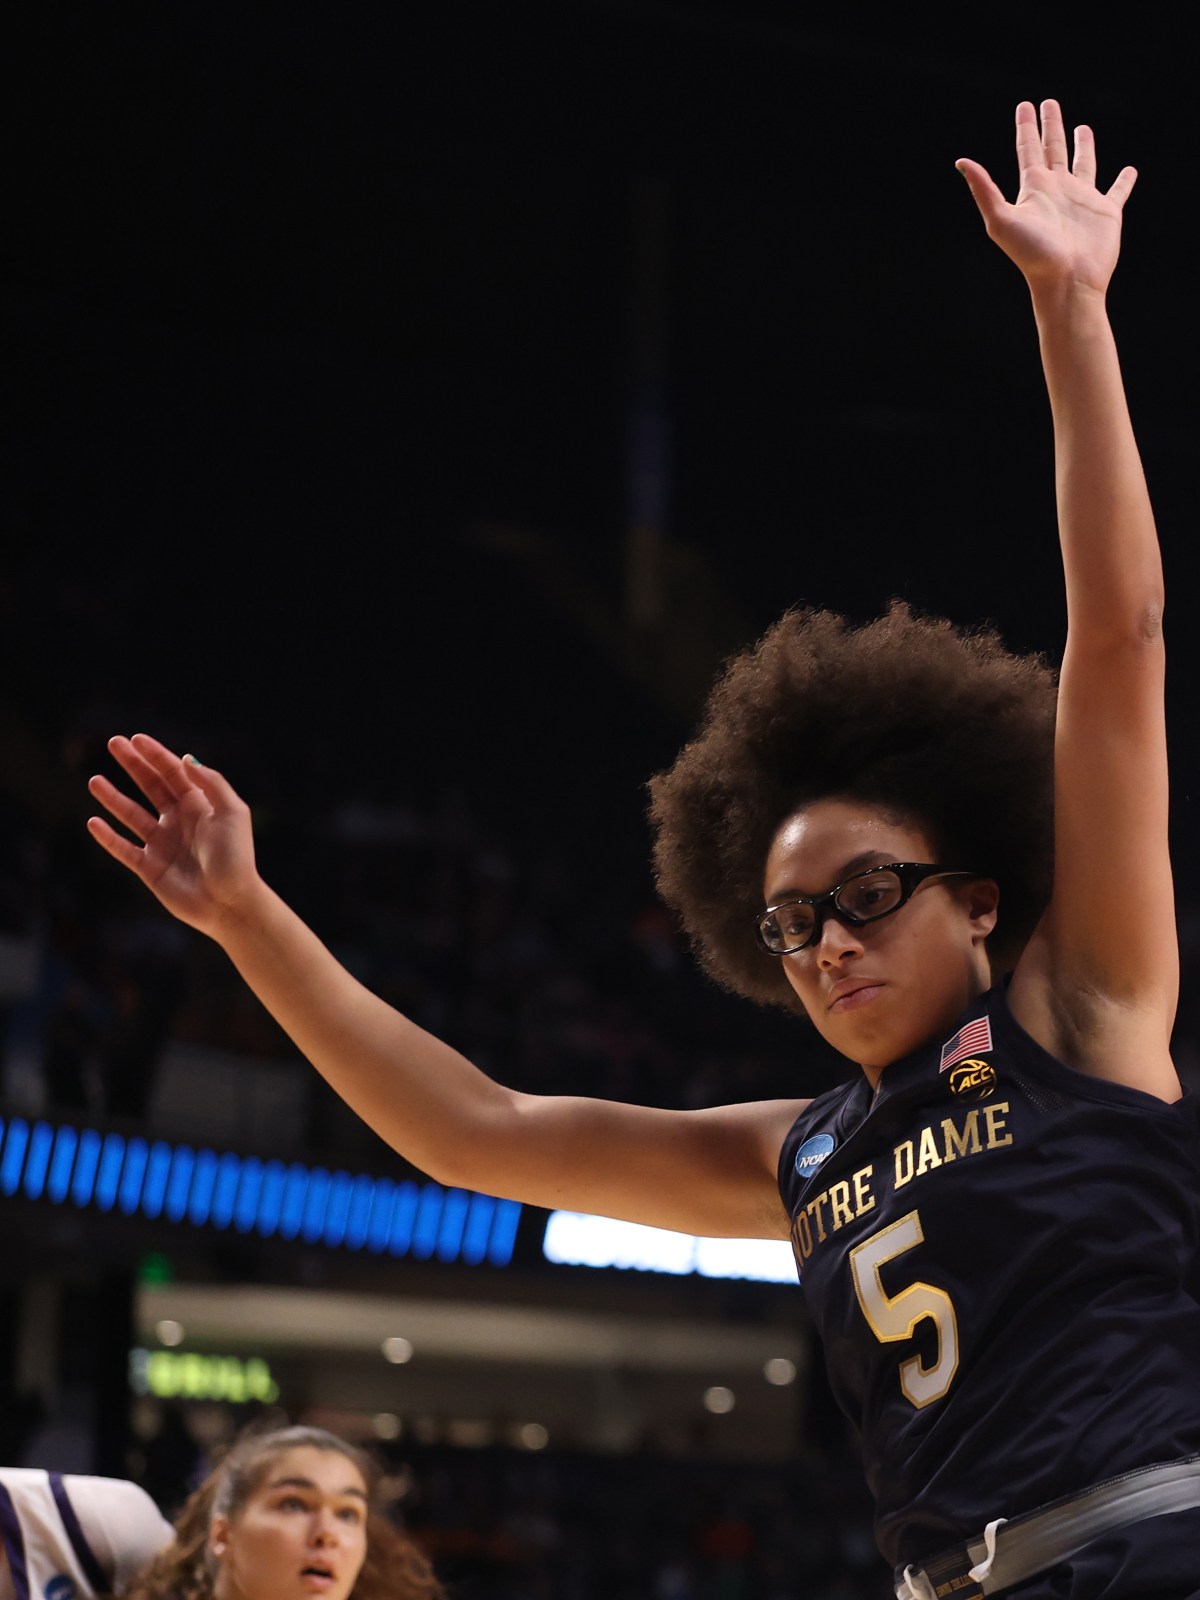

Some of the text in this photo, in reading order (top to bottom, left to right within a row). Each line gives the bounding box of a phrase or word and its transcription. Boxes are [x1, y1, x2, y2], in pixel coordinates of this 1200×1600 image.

[958, 1066, 992, 1092] ACC
[893, 1102, 1014, 1190] DAME
[848, 1209, 960, 1410] 5
